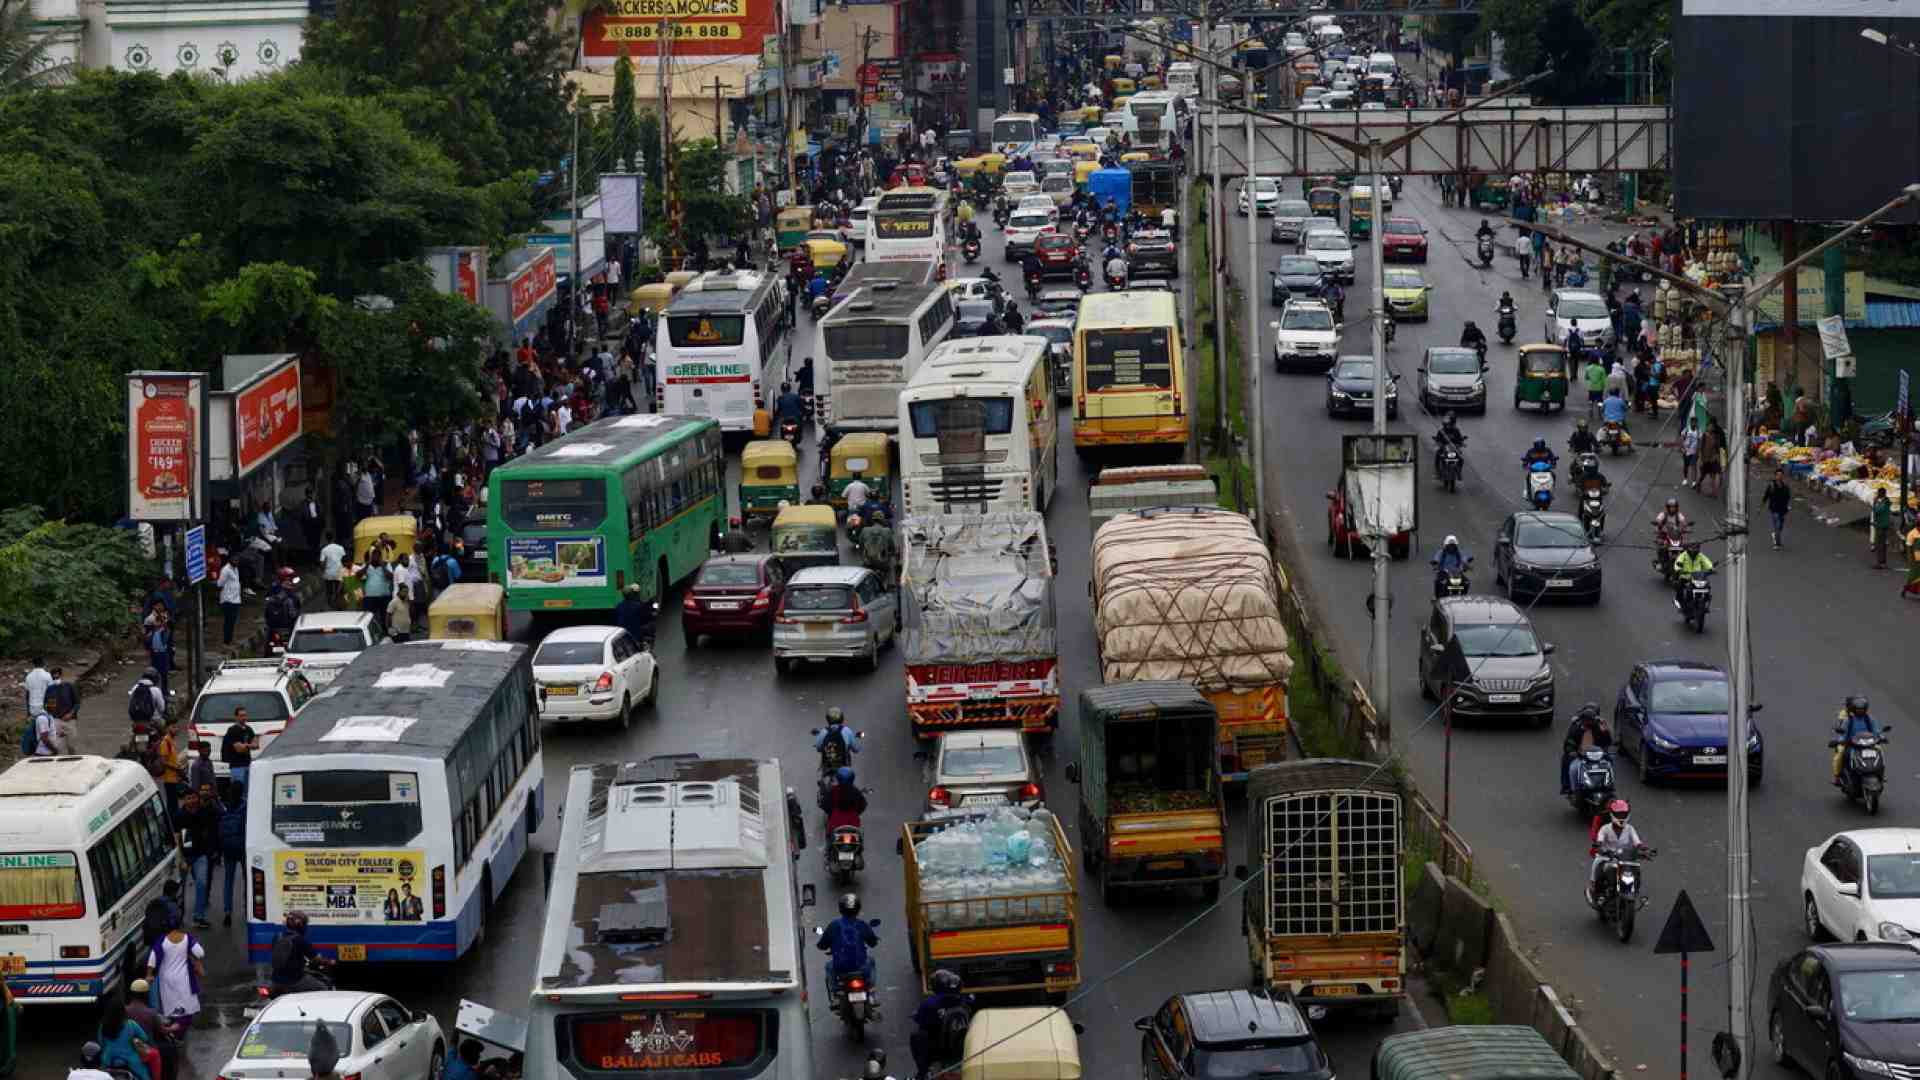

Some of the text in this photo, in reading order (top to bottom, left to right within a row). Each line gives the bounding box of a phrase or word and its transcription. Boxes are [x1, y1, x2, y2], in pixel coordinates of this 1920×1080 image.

[610, 0, 663, 15] ACKERS
[625, 27, 651, 37] 888
[700, 26, 729, 37] 888
[673, 363, 741, 376] GREENLINE
[304, 857, 393, 866] SILICON CITY COLLEGE
[326, 895, 357, 909] MBA
[601, 1052, 722, 1069] BALAJI CABS
